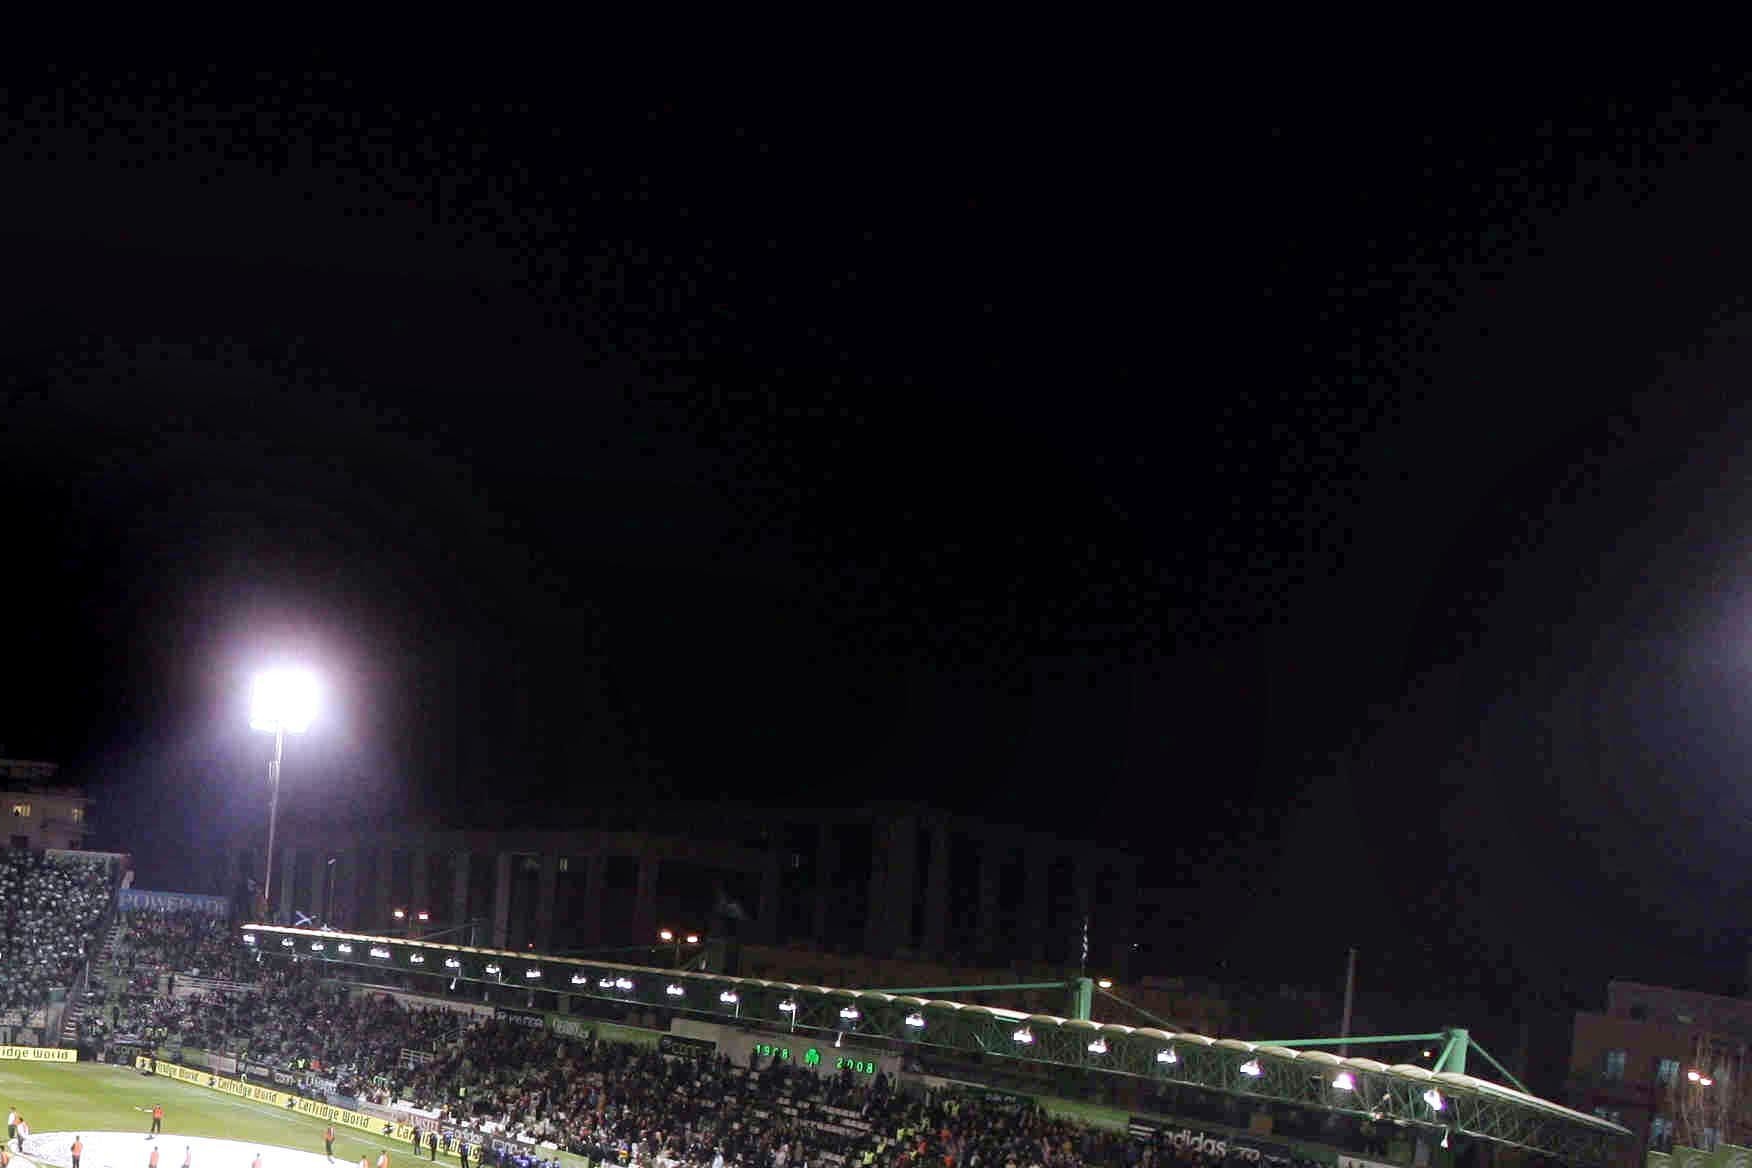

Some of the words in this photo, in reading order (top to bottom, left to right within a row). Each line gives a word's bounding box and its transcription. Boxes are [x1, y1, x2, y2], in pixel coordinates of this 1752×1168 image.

[33, 1049, 69, 1061] World
[217, 1077, 252, 1097] Cartridge
[254, 1086, 278, 1104] World
[298, 1099, 339, 1121] Cartridge
[342, 1107, 370, 1128] World
